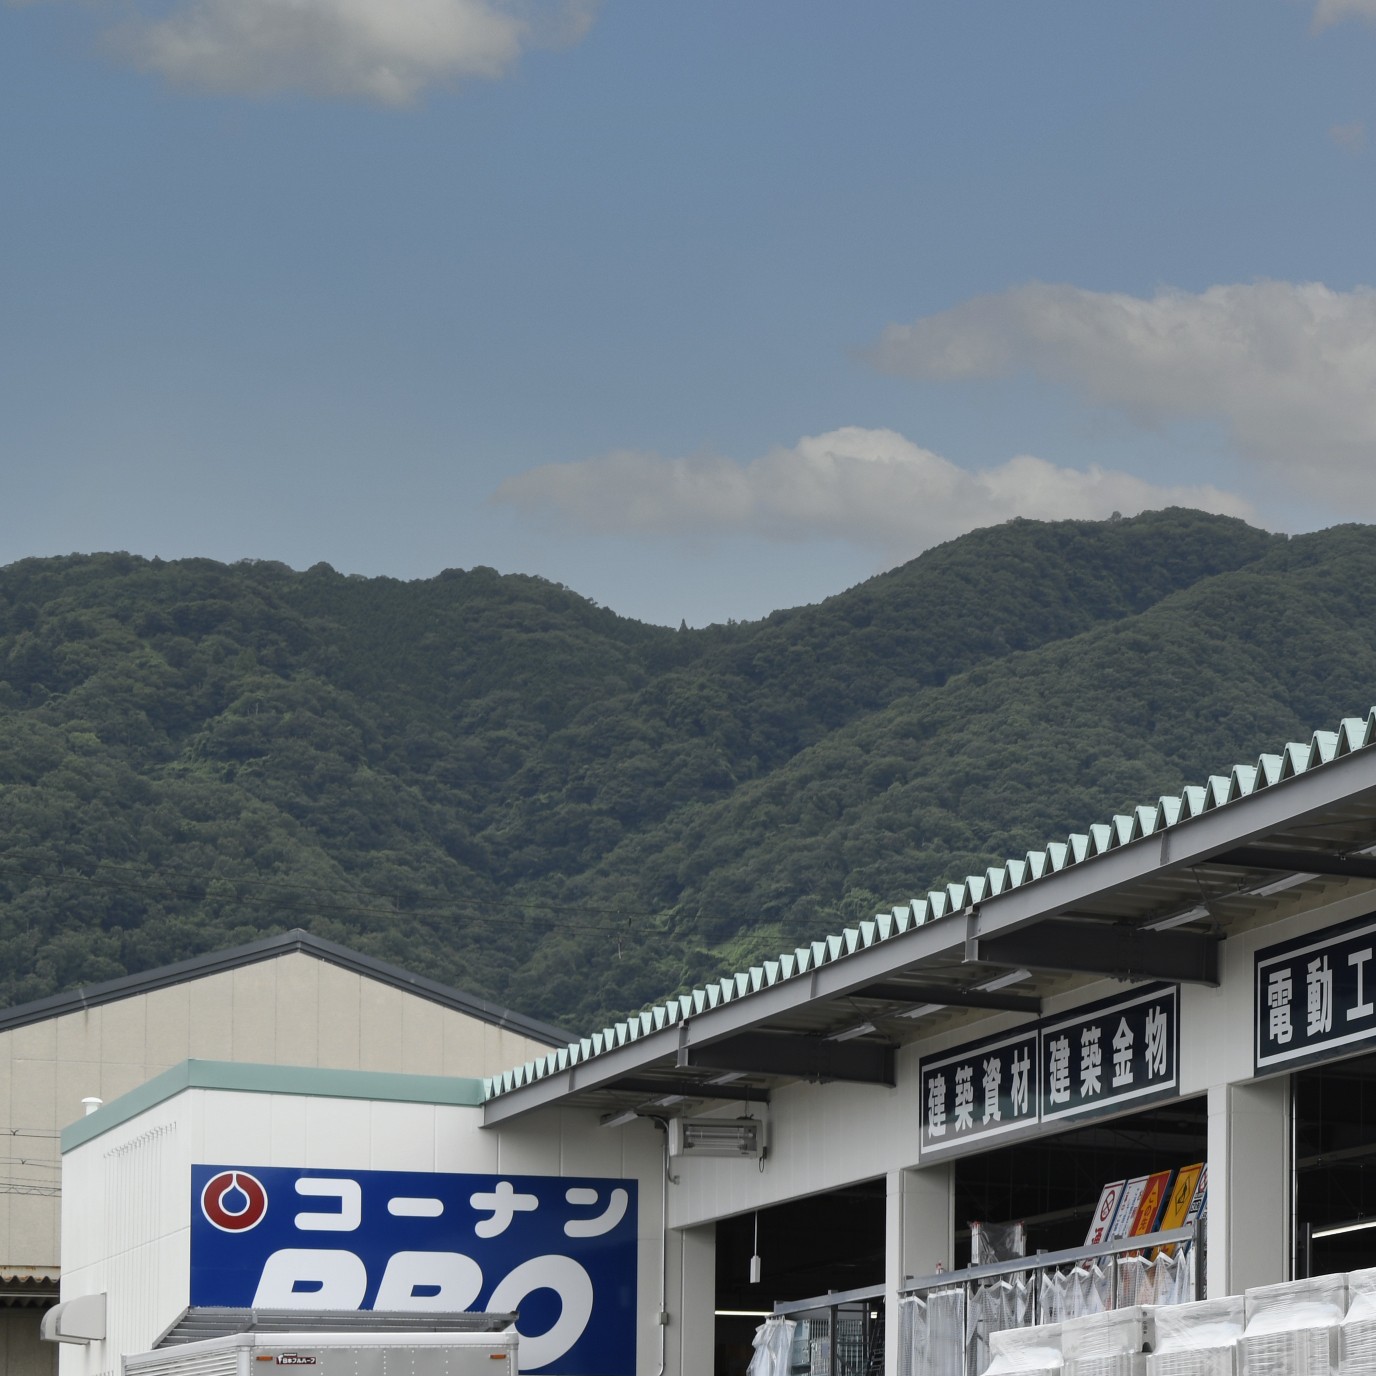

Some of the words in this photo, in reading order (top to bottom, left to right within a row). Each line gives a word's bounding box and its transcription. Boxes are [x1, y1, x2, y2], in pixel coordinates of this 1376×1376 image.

[928, 1046, 1031, 1139] 建築資材
[1050, 1005, 1167, 1106] 建築金物
[294, 1177, 629, 1239] コーナン
